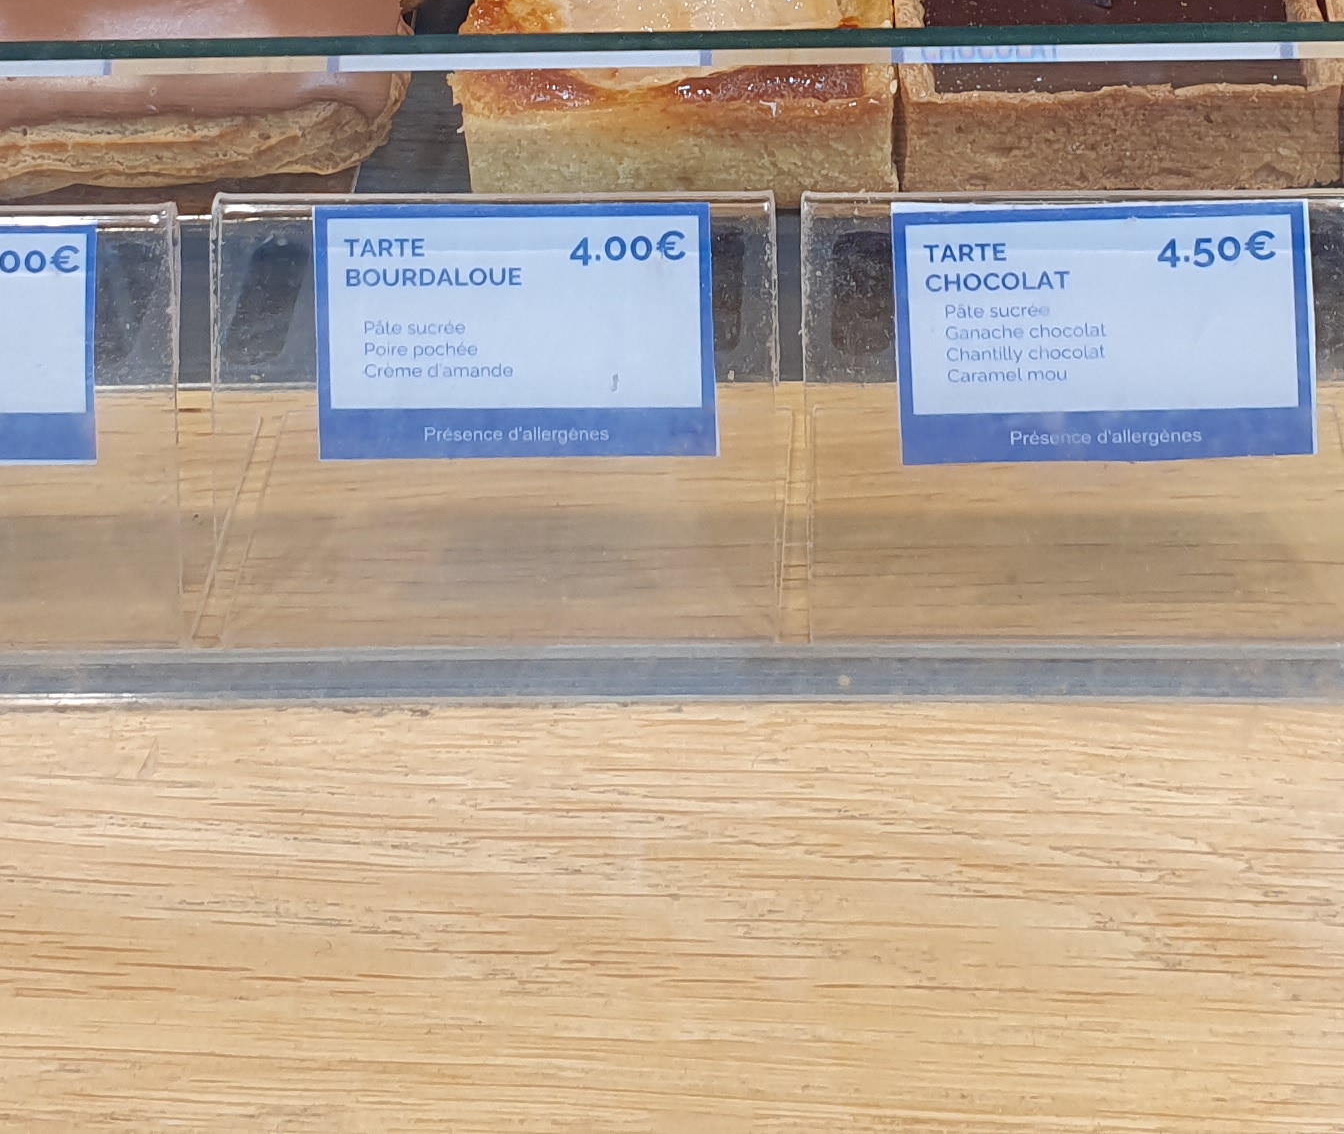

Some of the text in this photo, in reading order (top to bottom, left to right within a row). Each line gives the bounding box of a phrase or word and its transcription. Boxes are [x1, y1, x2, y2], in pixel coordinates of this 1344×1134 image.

[344, 238, 425, 258] TARTE
[569, 230, 687, 266] 4.00€
[923, 242, 1007, 263] TARTE
[1157, 230, 1277, 268] 4.50€
[345, 267, 523, 287] BOURDALOUE
[924, 270, 1071, 293] CHOCOLAT
[944, 302, 1050, 319] Pâte sucrée
[363, 319, 466, 336] Pâte sucrée
[945, 322, 1107, 340] Ganache chocolat
[364, 340, 478, 359] Poire pochée
[946, 344, 1106, 364] Chantilly chocolat
[364, 362, 514, 379] Crème d'amande
[947, 367, 1069, 384] Caramel mou
[424, 426, 503, 442] Présence
[1010, 428, 1203, 447] Présence d'allergènes
